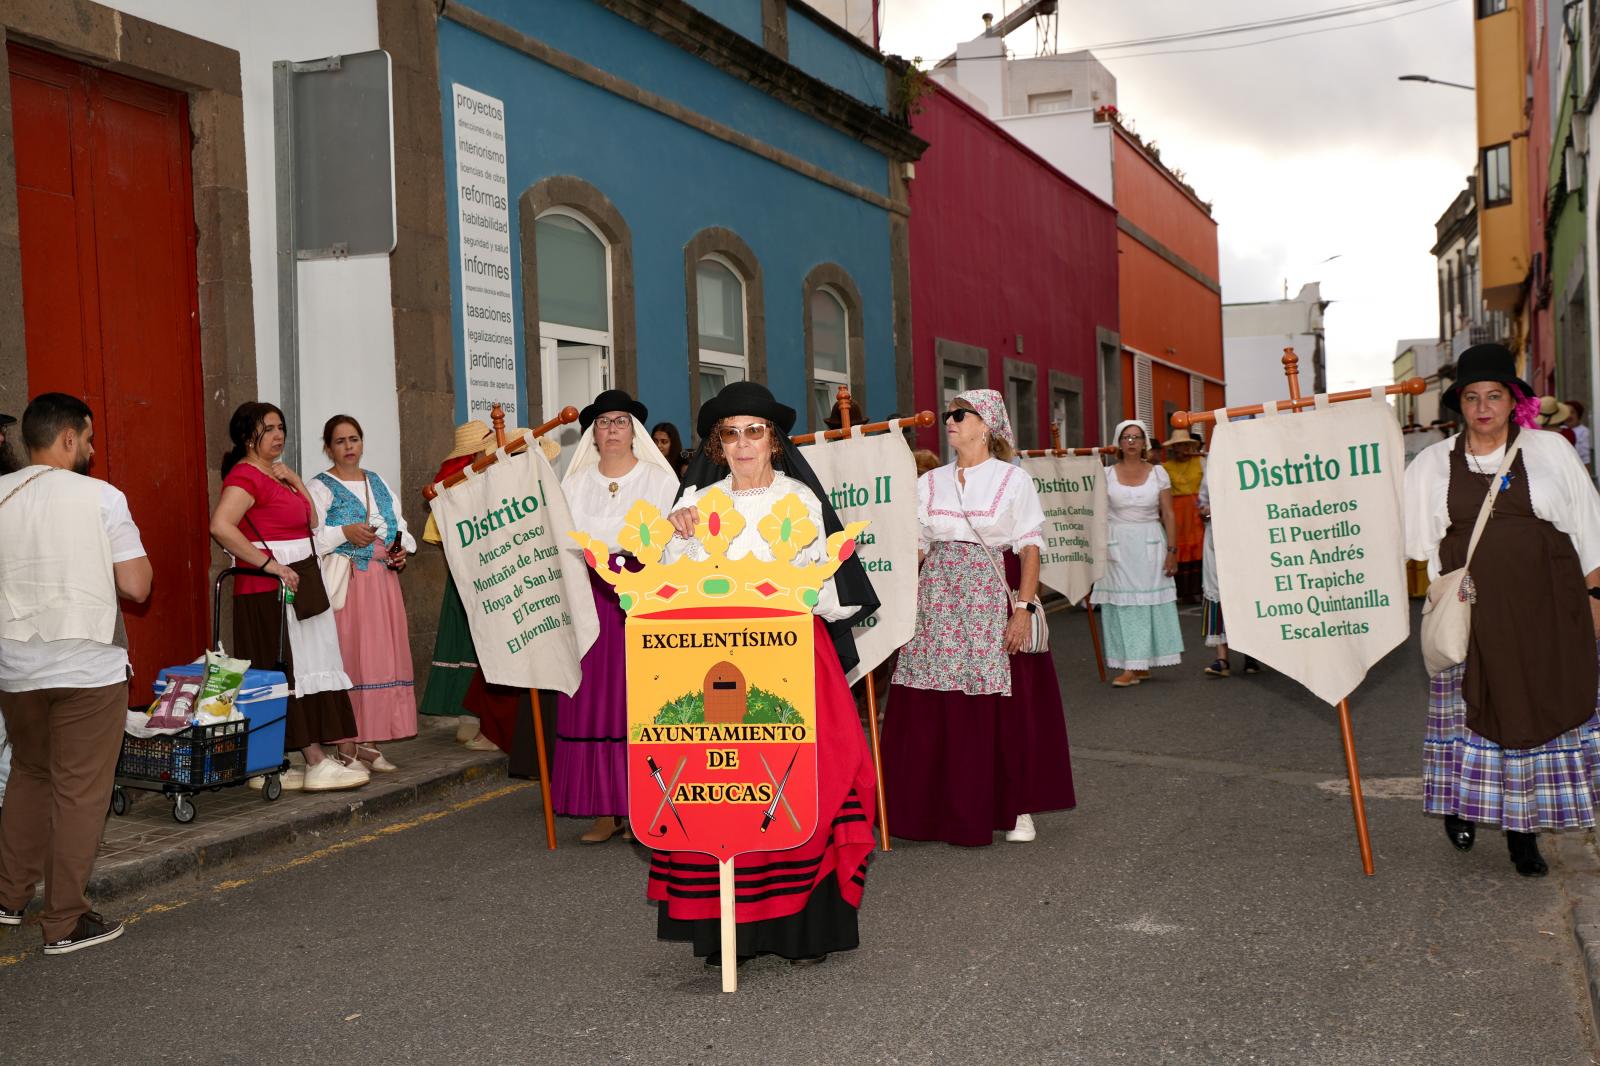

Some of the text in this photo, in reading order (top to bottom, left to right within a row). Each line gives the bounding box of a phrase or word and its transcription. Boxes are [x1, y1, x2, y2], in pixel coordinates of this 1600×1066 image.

[457, 94, 503, 121] proyectos
[458, 118, 485, 134] direcciones
[493, 131, 504, 141] obra
[459, 136, 505, 165] interiorismo
[460, 162, 506, 184] licencias de obra
[461, 184, 507, 210] reformas
[462, 210, 508, 234] habitabilidad
[463, 236, 489, 248] seguridad
[494, 243, 509, 254] salud
[464, 253, 510, 281] informes
[466, 302, 512, 324] tasaciones
[467, 327, 513, 346] legalizaciones
[470, 377, 488, 388] licencias
[496, 380, 515, 391] apertura
[471, 397, 516, 413] peritanes
[1236, 442, 1382, 491] Distrito III
[875, 475, 891, 504] II
[1032, 475, 1096, 493] Distrito IV
[456, 480, 547, 548] Distrito I
[1266, 499, 1358, 520] Bañaderos
[1048, 537, 1057, 548] El
[1268, 520, 1361, 544] El Puertillo
[479, 524, 545, 567] Arucas Casco
[1270, 543, 1365, 568] San Andrés
[473, 544, 559, 594] Montaña de Arucas
[1040, 553, 1050, 564] El
[1051, 551, 1084, 563] Hornillo
[1274, 569, 1366, 592] El Trapiche
[482, 595, 513, 616] Hoya
[513, 583, 524, 599] de
[524, 574, 547, 591] San
[1255, 589, 1390, 618] Lomo Quintanilla
[512, 593, 561, 625] El Terrero
[507, 636, 521, 655] El
[521, 615, 561, 646] Hornillo
[642, 627, 798, 649] EXCELENTÍSIMO
[1280, 621, 1370, 640] Escaleritas
[640, 725, 806, 743] AYUNTAMIENTO
[708, 751, 738, 768] DE
[674, 785, 772, 802] ARUCAS
